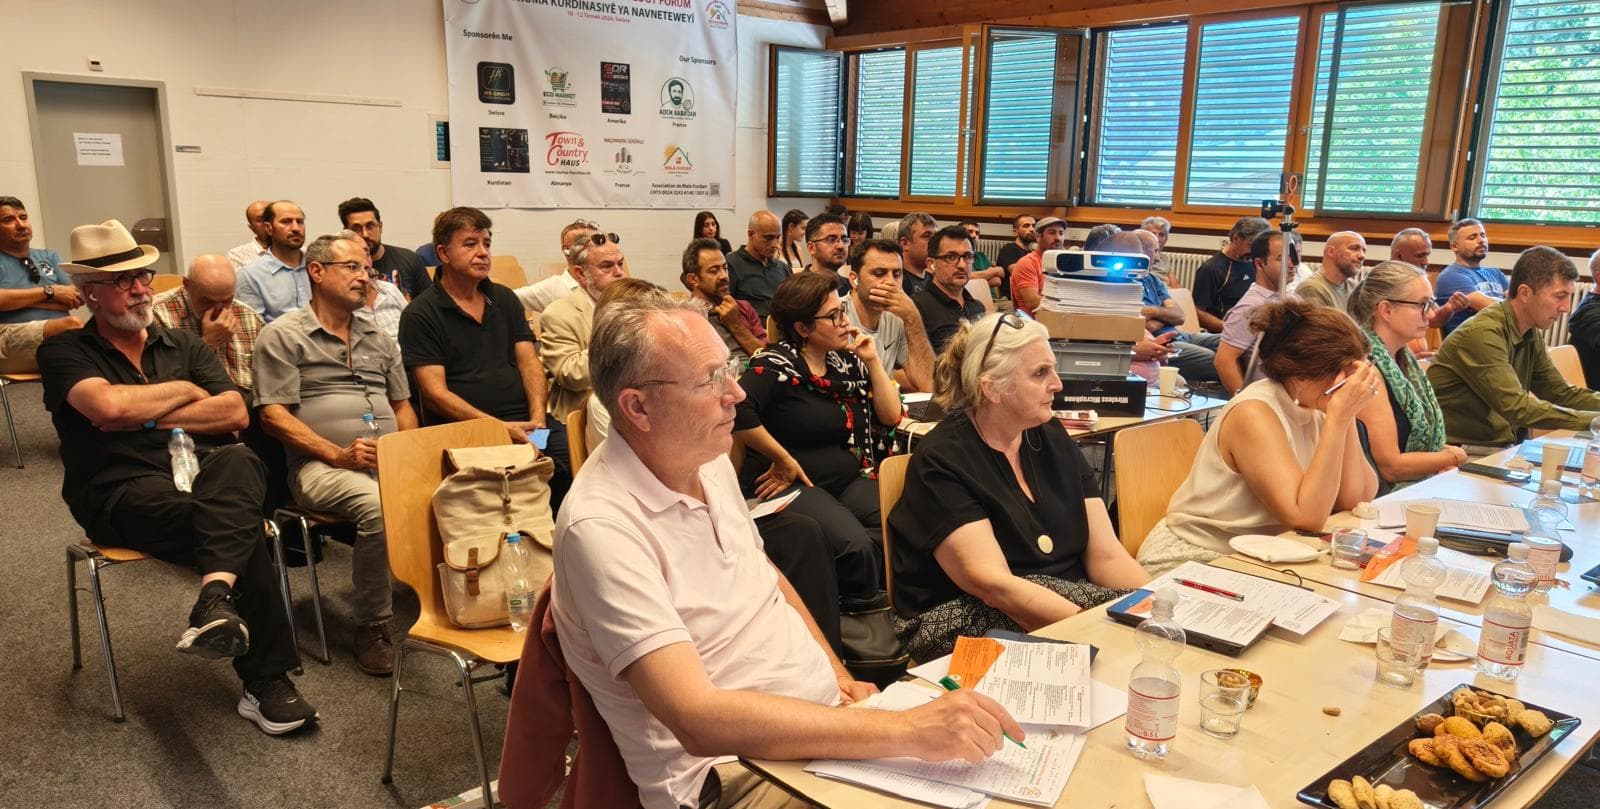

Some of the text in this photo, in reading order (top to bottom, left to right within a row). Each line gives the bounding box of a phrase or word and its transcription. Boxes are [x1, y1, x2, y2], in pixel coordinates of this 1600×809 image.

[617, 6, 629, 15] YA
[502, 33, 512, 41] Me
[691, 57, 716, 66] Sponsors
[545, 131, 584, 148] Town &
[547, 145, 588, 166] Country
[1064, 396, 1128, 404] Wireless Microphone
[1505, 631, 1520, 660] AQUATA
